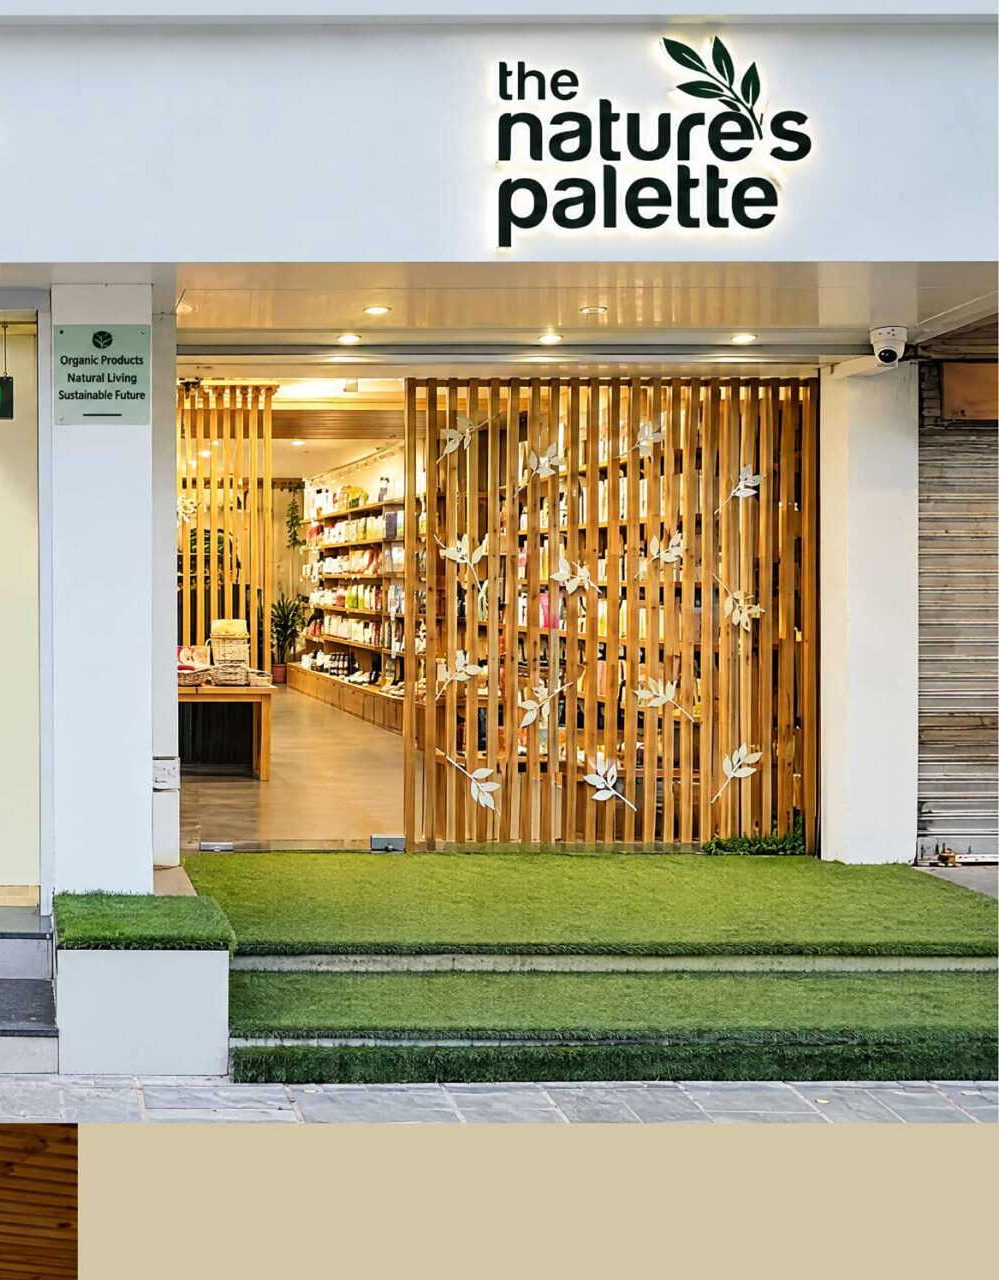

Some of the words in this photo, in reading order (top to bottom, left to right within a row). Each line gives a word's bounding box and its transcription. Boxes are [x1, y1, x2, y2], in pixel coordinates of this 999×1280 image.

[499, 61, 579, 101] the
[498, 165, 779, 249] palette
[60, 355, 99, 367] Organic
[101, 354, 144, 365] Products
[67, 372, 105, 383] Natural
[107, 372, 138, 385] Living
[58, 389, 113, 400] Sustainable
[115, 389, 146, 400] Future
